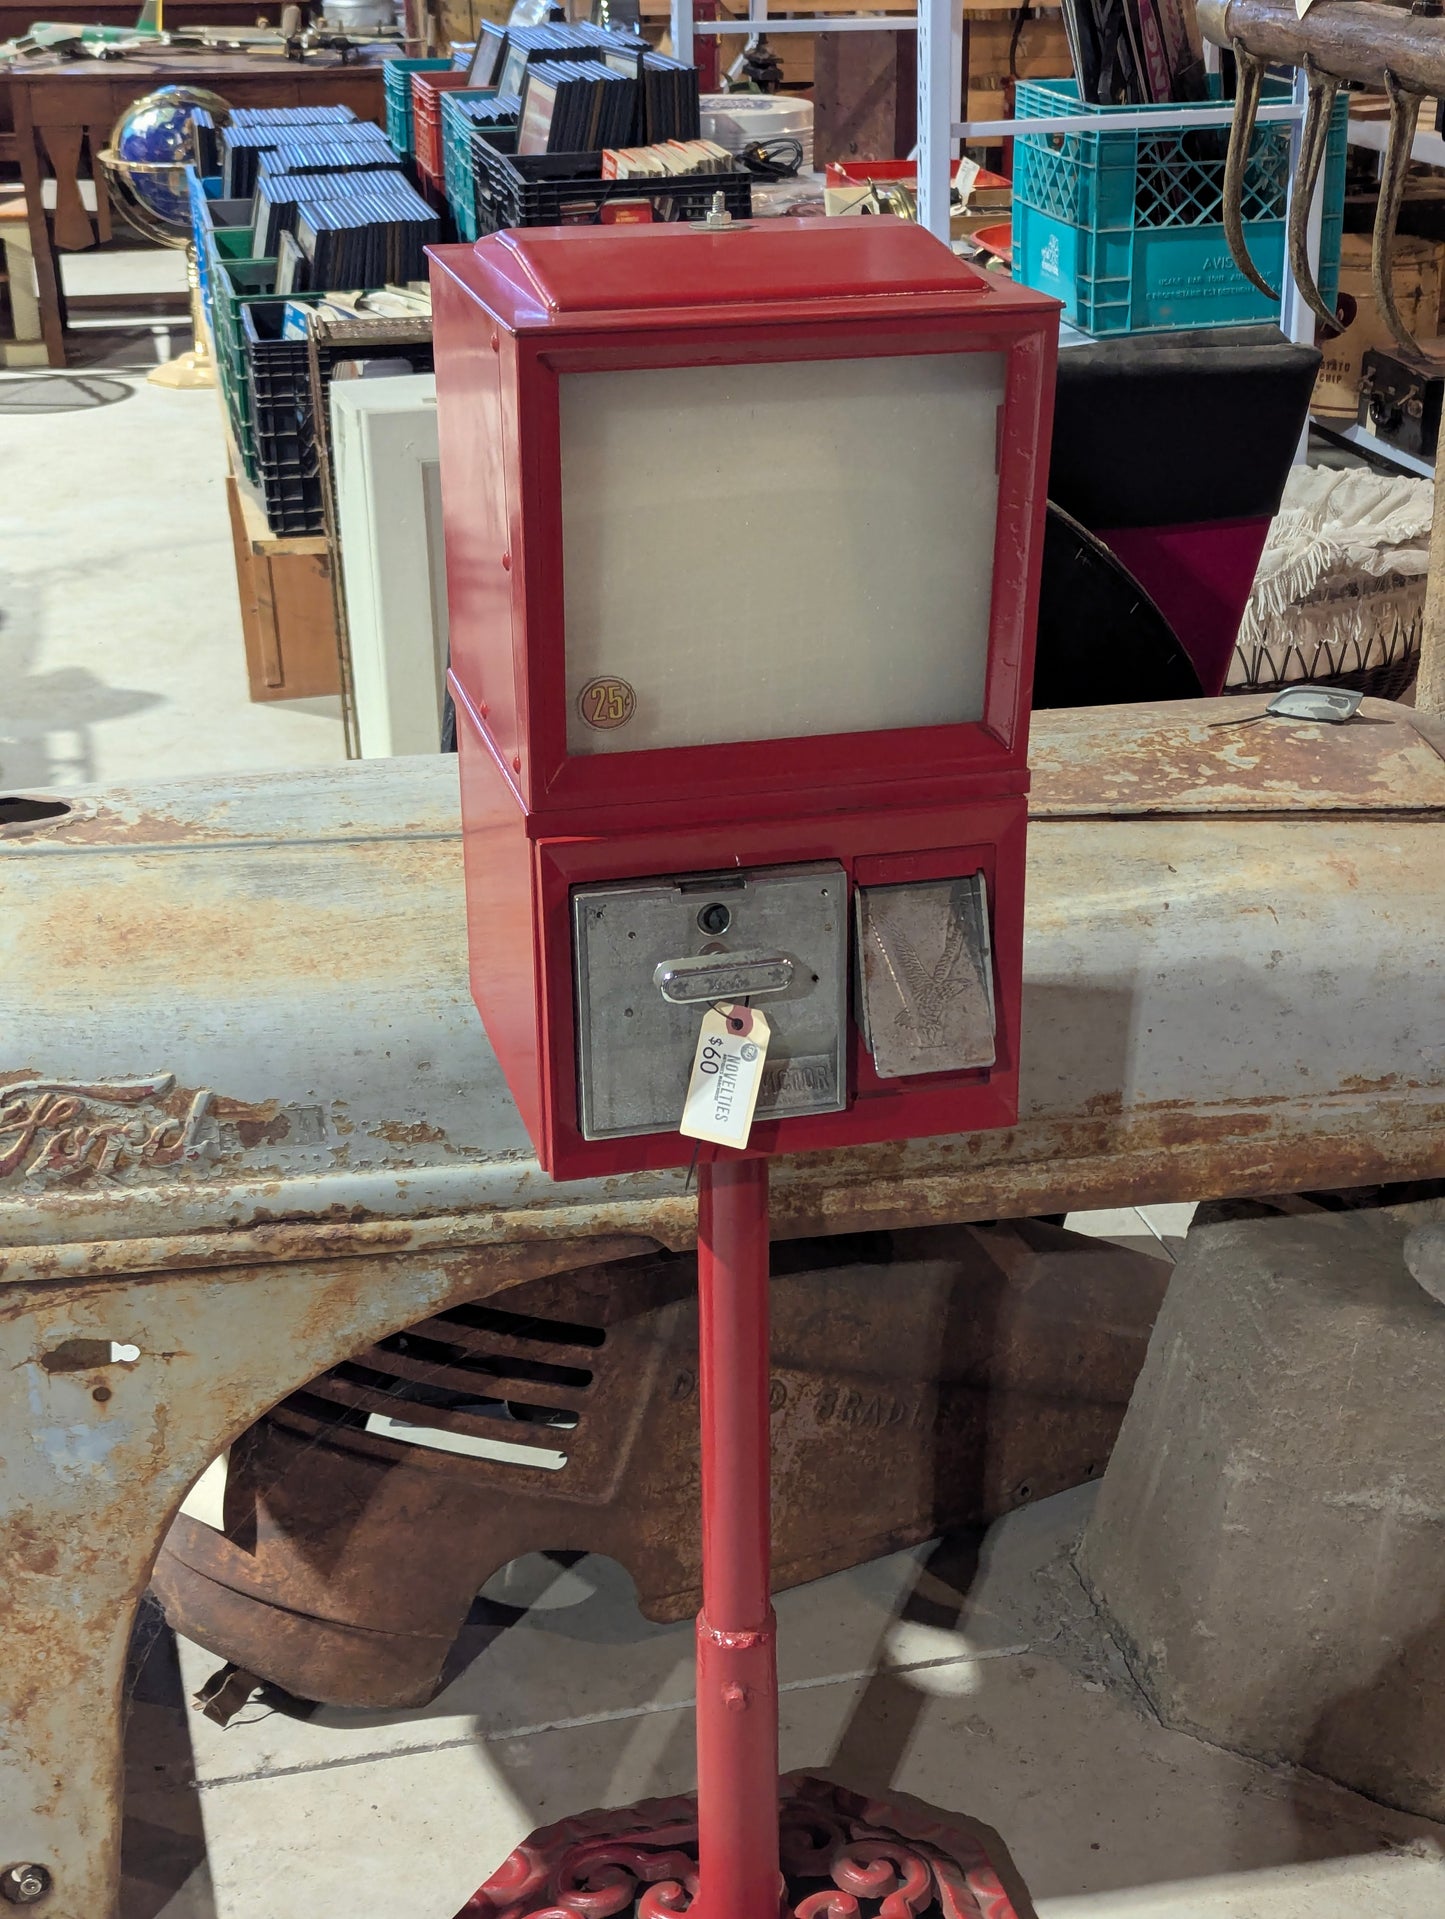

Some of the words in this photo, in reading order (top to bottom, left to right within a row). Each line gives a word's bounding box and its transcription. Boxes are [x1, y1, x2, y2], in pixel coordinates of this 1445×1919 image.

[1203, 257, 1233, 270] AVIS
[1318, 372, 1343, 384] CHIP
[1320, 359, 1351, 373] OTATO
[700, 1036, 724, 1075] $60
[714, 1054, 742, 1123] NOVELTIES
[0, 1075, 213, 1178] Ford
